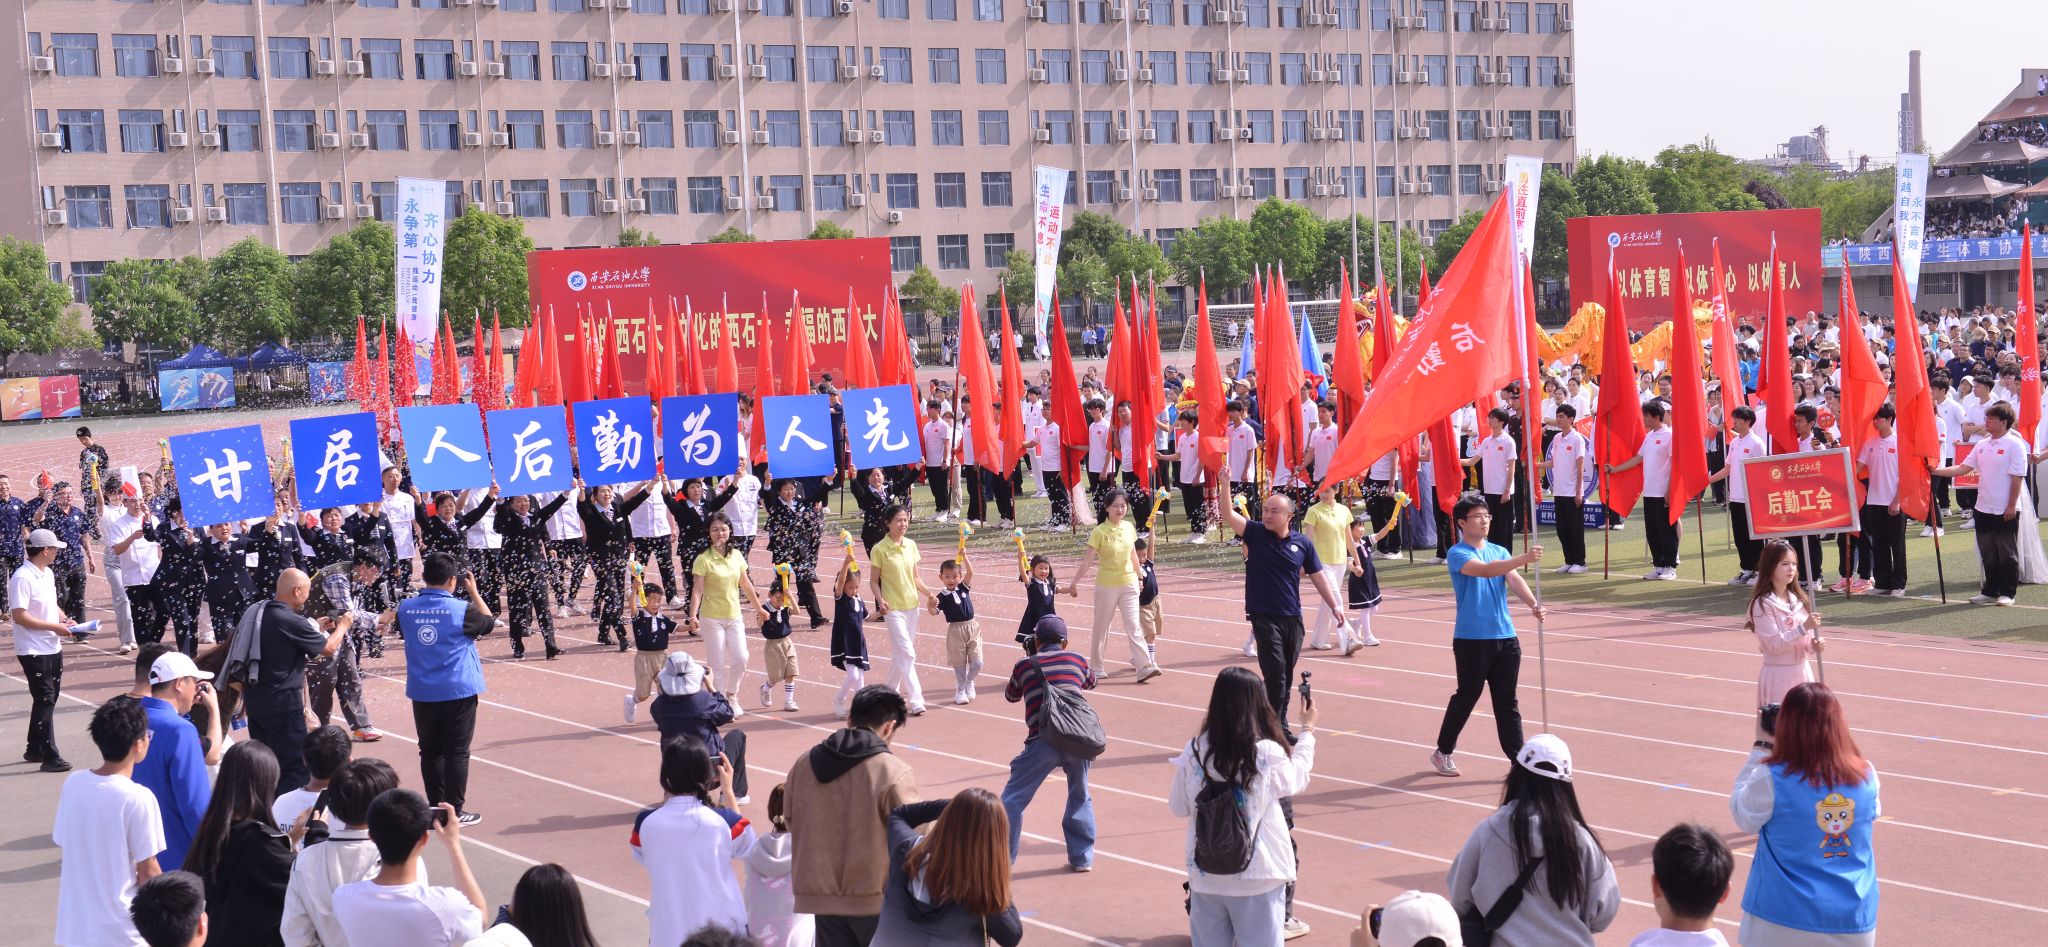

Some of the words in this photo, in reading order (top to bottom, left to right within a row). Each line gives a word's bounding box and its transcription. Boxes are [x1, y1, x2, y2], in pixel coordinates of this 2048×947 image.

[1037, 184, 1050, 244] 生命不息
[1899, 168, 1912, 220] 超越自我
[403, 198, 419, 259] 永争第一
[422, 212, 439, 284] 齐心协力
[1044, 206, 1060, 265] 运动不止
[1908, 197, 1922, 250] 永不言败
[1616, 266, 1670, 298] 以体育智
[1686, 264, 1737, 295] 以体心
[423, 426, 481, 463] 人
[510, 421, 553, 483] 后
[591, 410, 642, 472] 勤
[680, 405, 721, 465] 为
[779, 416, 828, 451] 人
[863, 398, 909, 453] 先
[191, 449, 252, 503] 甘
[314, 430, 362, 493] 居
[1767, 486, 1833, 515] 后勤工会
